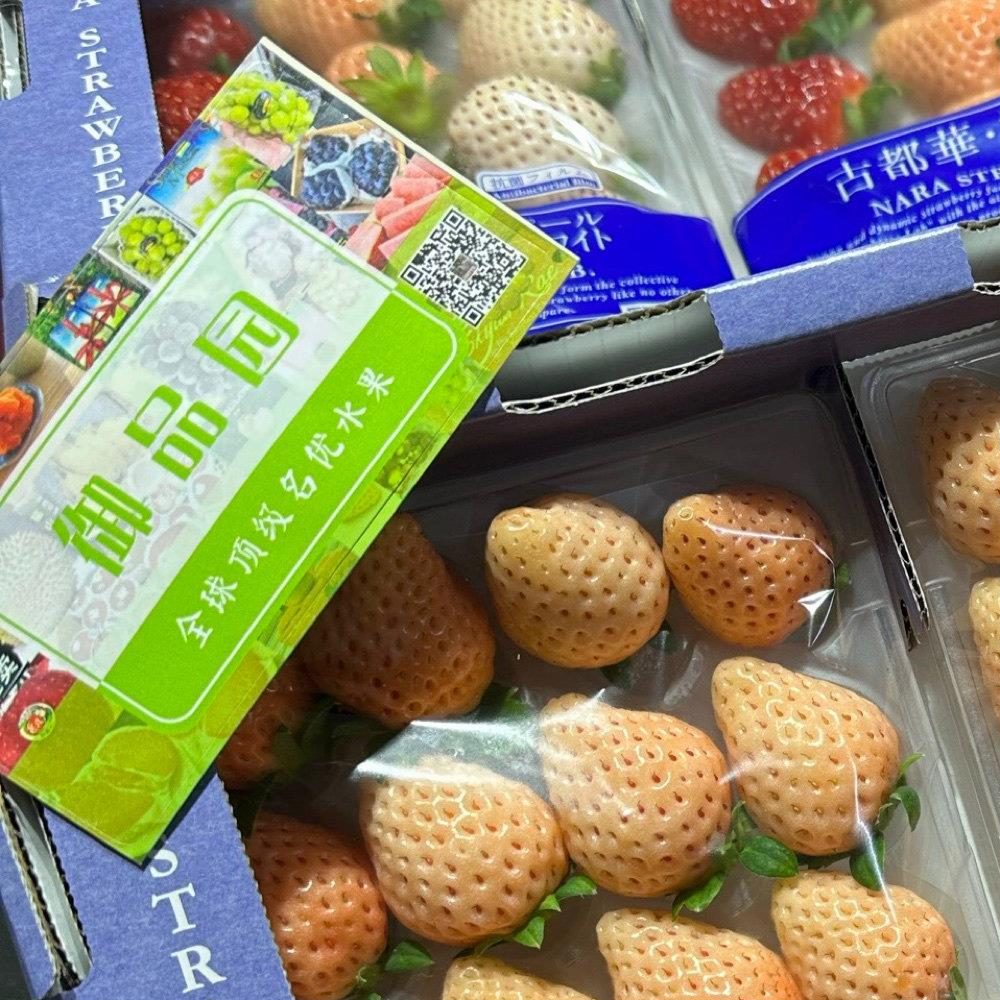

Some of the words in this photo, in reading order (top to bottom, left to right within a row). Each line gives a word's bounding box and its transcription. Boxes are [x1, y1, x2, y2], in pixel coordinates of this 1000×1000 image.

[77, 28, 126, 226] STRAWBER
[529, 207, 604, 229] ール
[870, 176, 951, 218] NARA
[561, 284, 593, 295] form
[595, 280, 616, 291] the
[618, 272, 679, 288] collective
[611, 287, 636, 301] like
[639, 286, 657, 298] no
[52, 289, 301, 578] 御品园
[175, 367, 395, 649] 全球顶级名优水果
